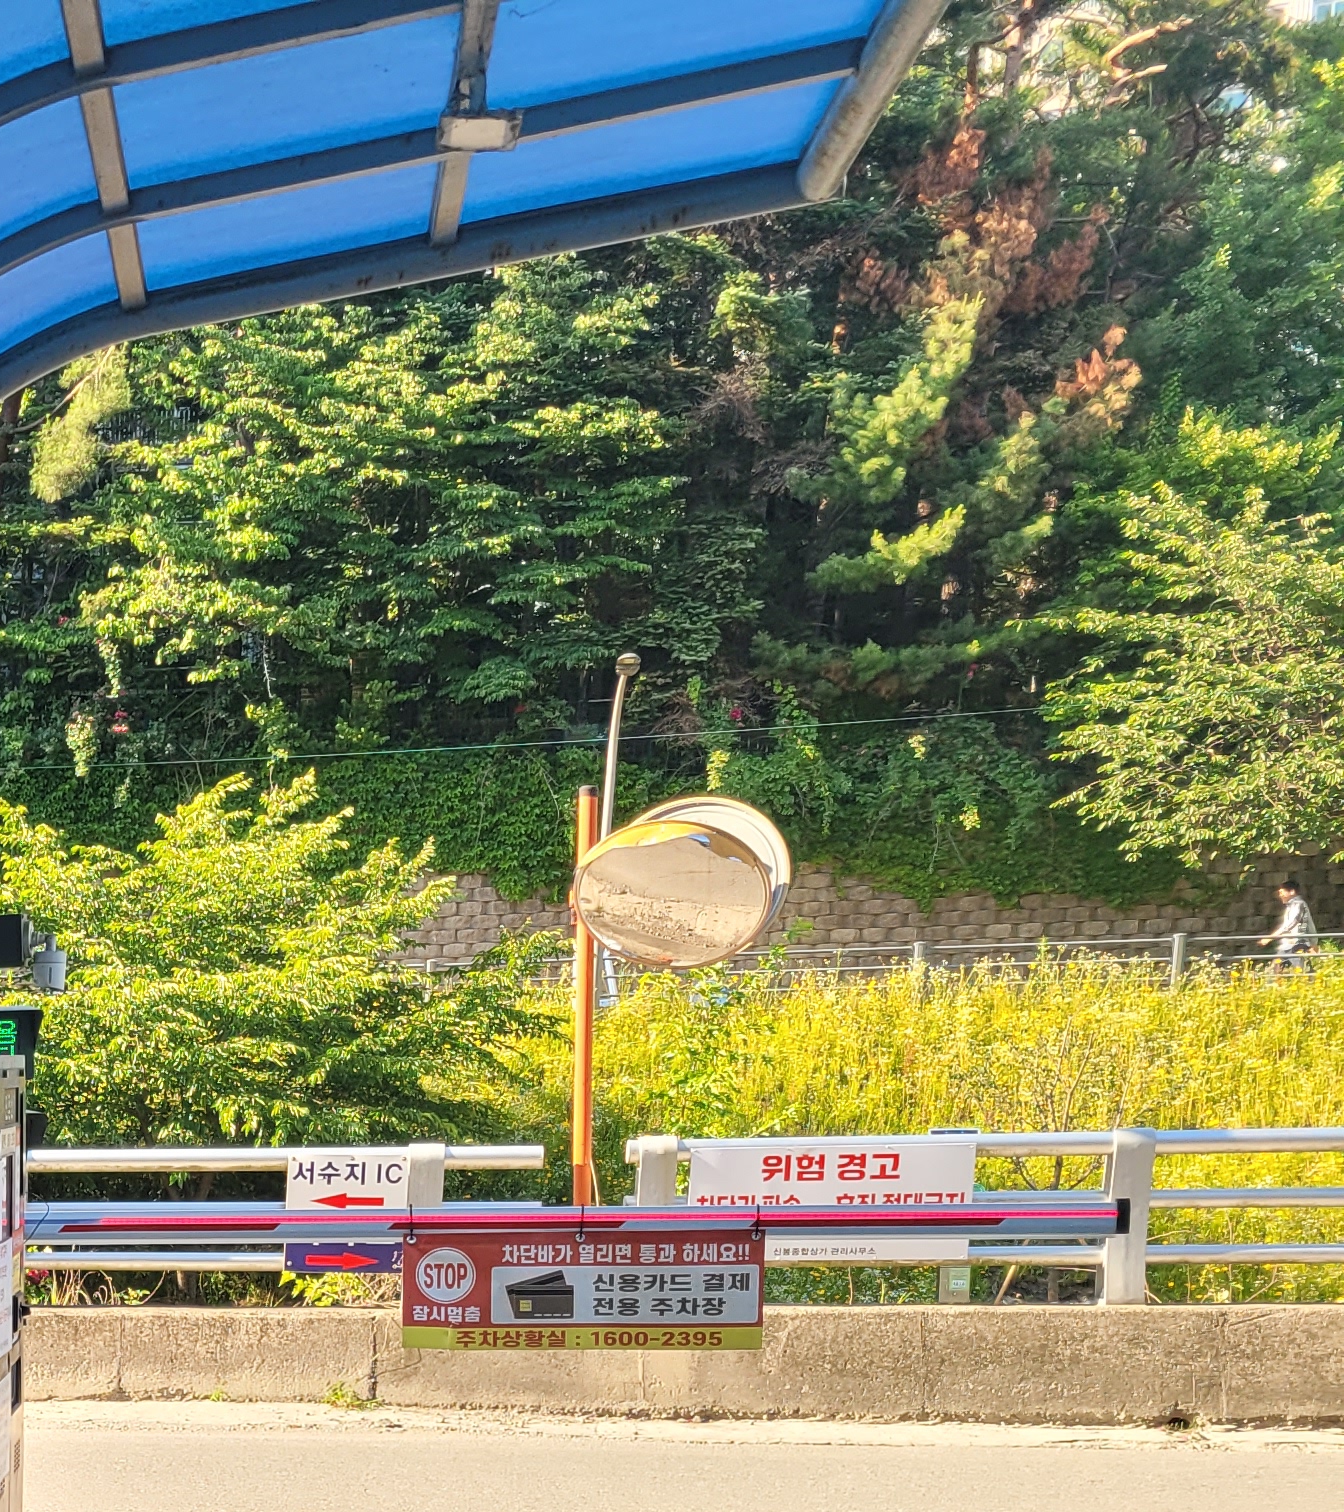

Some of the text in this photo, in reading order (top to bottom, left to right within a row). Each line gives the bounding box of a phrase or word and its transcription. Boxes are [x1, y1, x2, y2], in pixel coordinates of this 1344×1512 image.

[293, 1161, 403, 1186] 서수지 IC
[761, 1153, 901, 1182] 위험 경고
[502, 1243, 750, 1264] 차단바가 열리면 통과 하세요!!
[773, 1247, 876, 1256] 신봉종합상가 관리사무소
[423, 1263, 468, 1289] STOP
[593, 1272, 750, 1292] 신용카드 결제
[413, 1305, 481, 1323] 잠시멈춤
[593, 1297, 726, 1316] 전용 주차장
[456, 1330, 566, 1348] 주차상황실
[591, 1331, 723, 1347] 1600-2395
